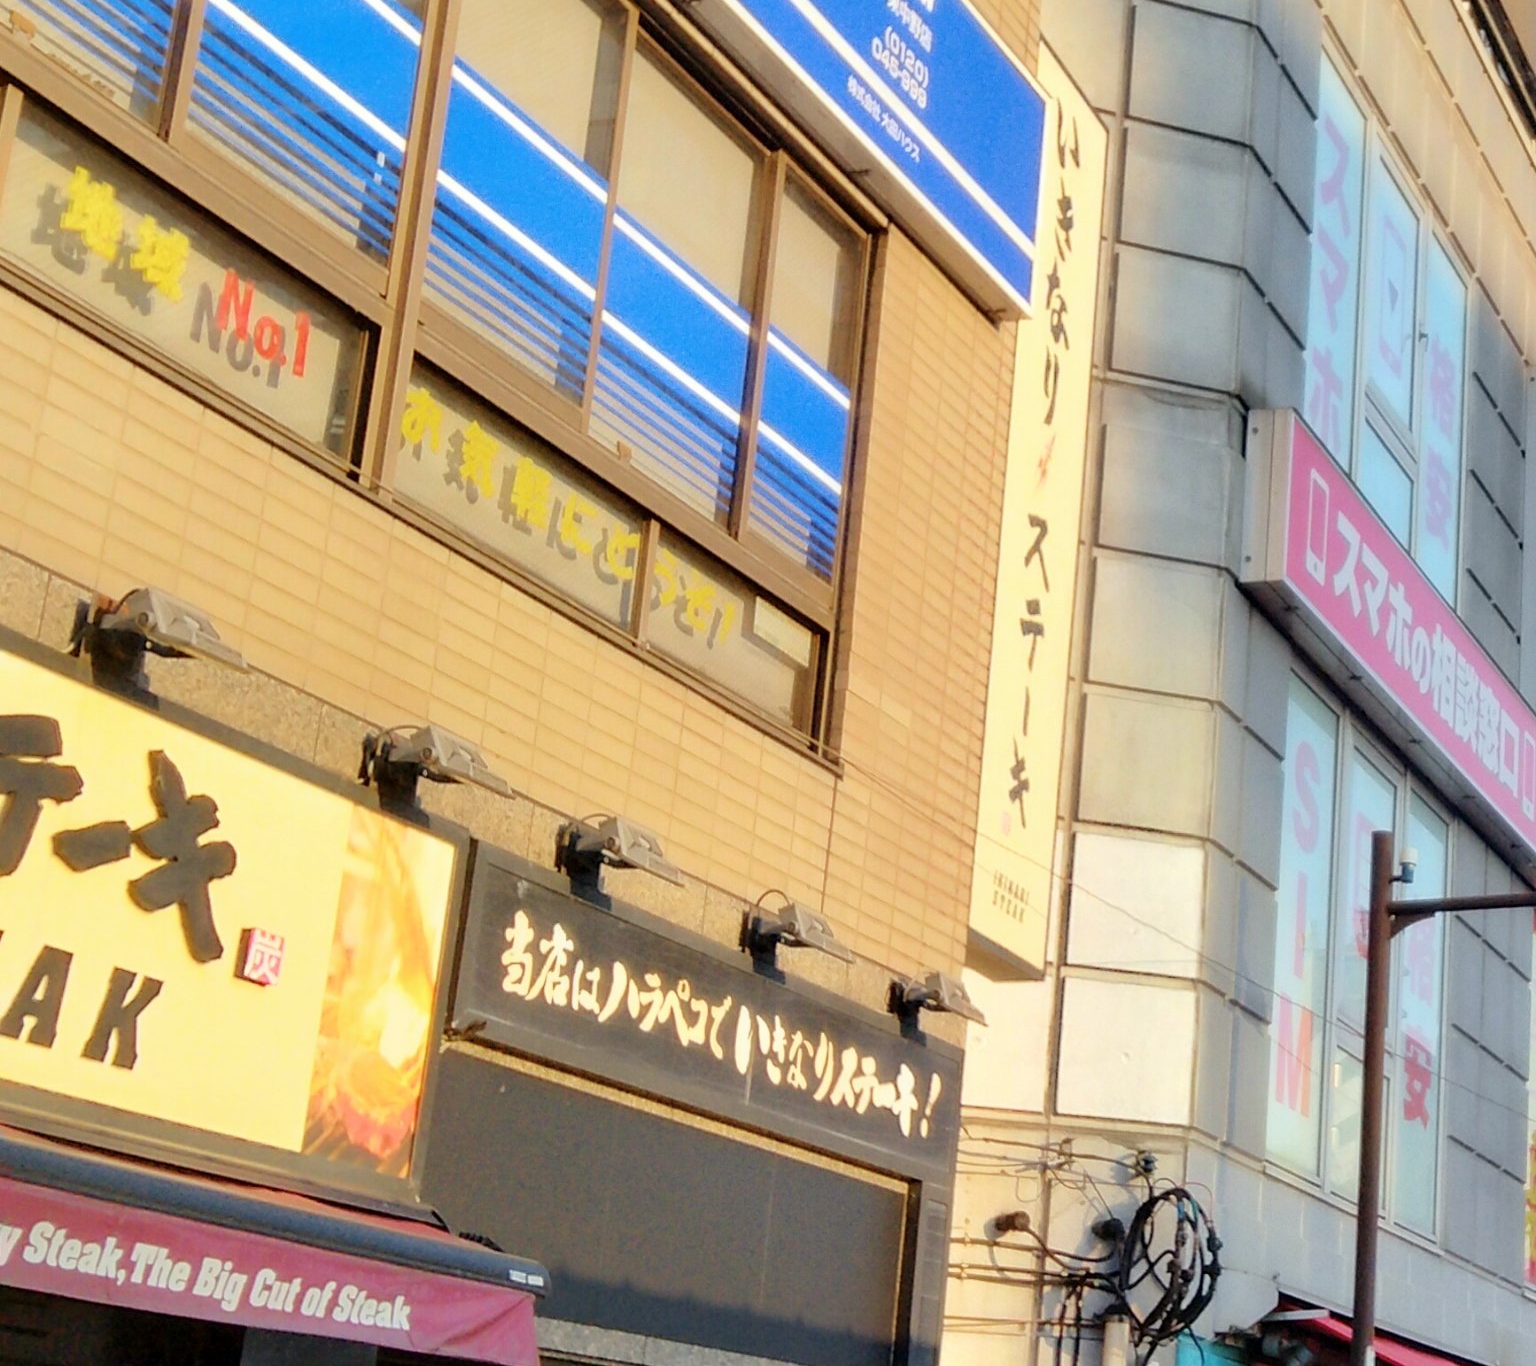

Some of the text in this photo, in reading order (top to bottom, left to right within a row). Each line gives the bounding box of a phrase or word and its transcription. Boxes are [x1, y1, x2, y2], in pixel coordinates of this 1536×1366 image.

[884, 25, 930, 88] (0120)
[216, 268, 312, 379] No.1
[1310, 110, 1351, 455] スマホ
[1008, 512, 1050, 831] ステーキ
[1332, 510, 1520, 801] スマホの相談窓口
[501, 909, 733, 1061] 当店はハラペコで
[23, 1220, 127, 1287] Steak,
[130, 1242, 188, 1293] The
[193, 1256, 248, 1312] Big
[250, 1267, 302, 1315] Cut
[302, 1283, 333, 1318] of
[332, 1284, 411, 1332] Steak
